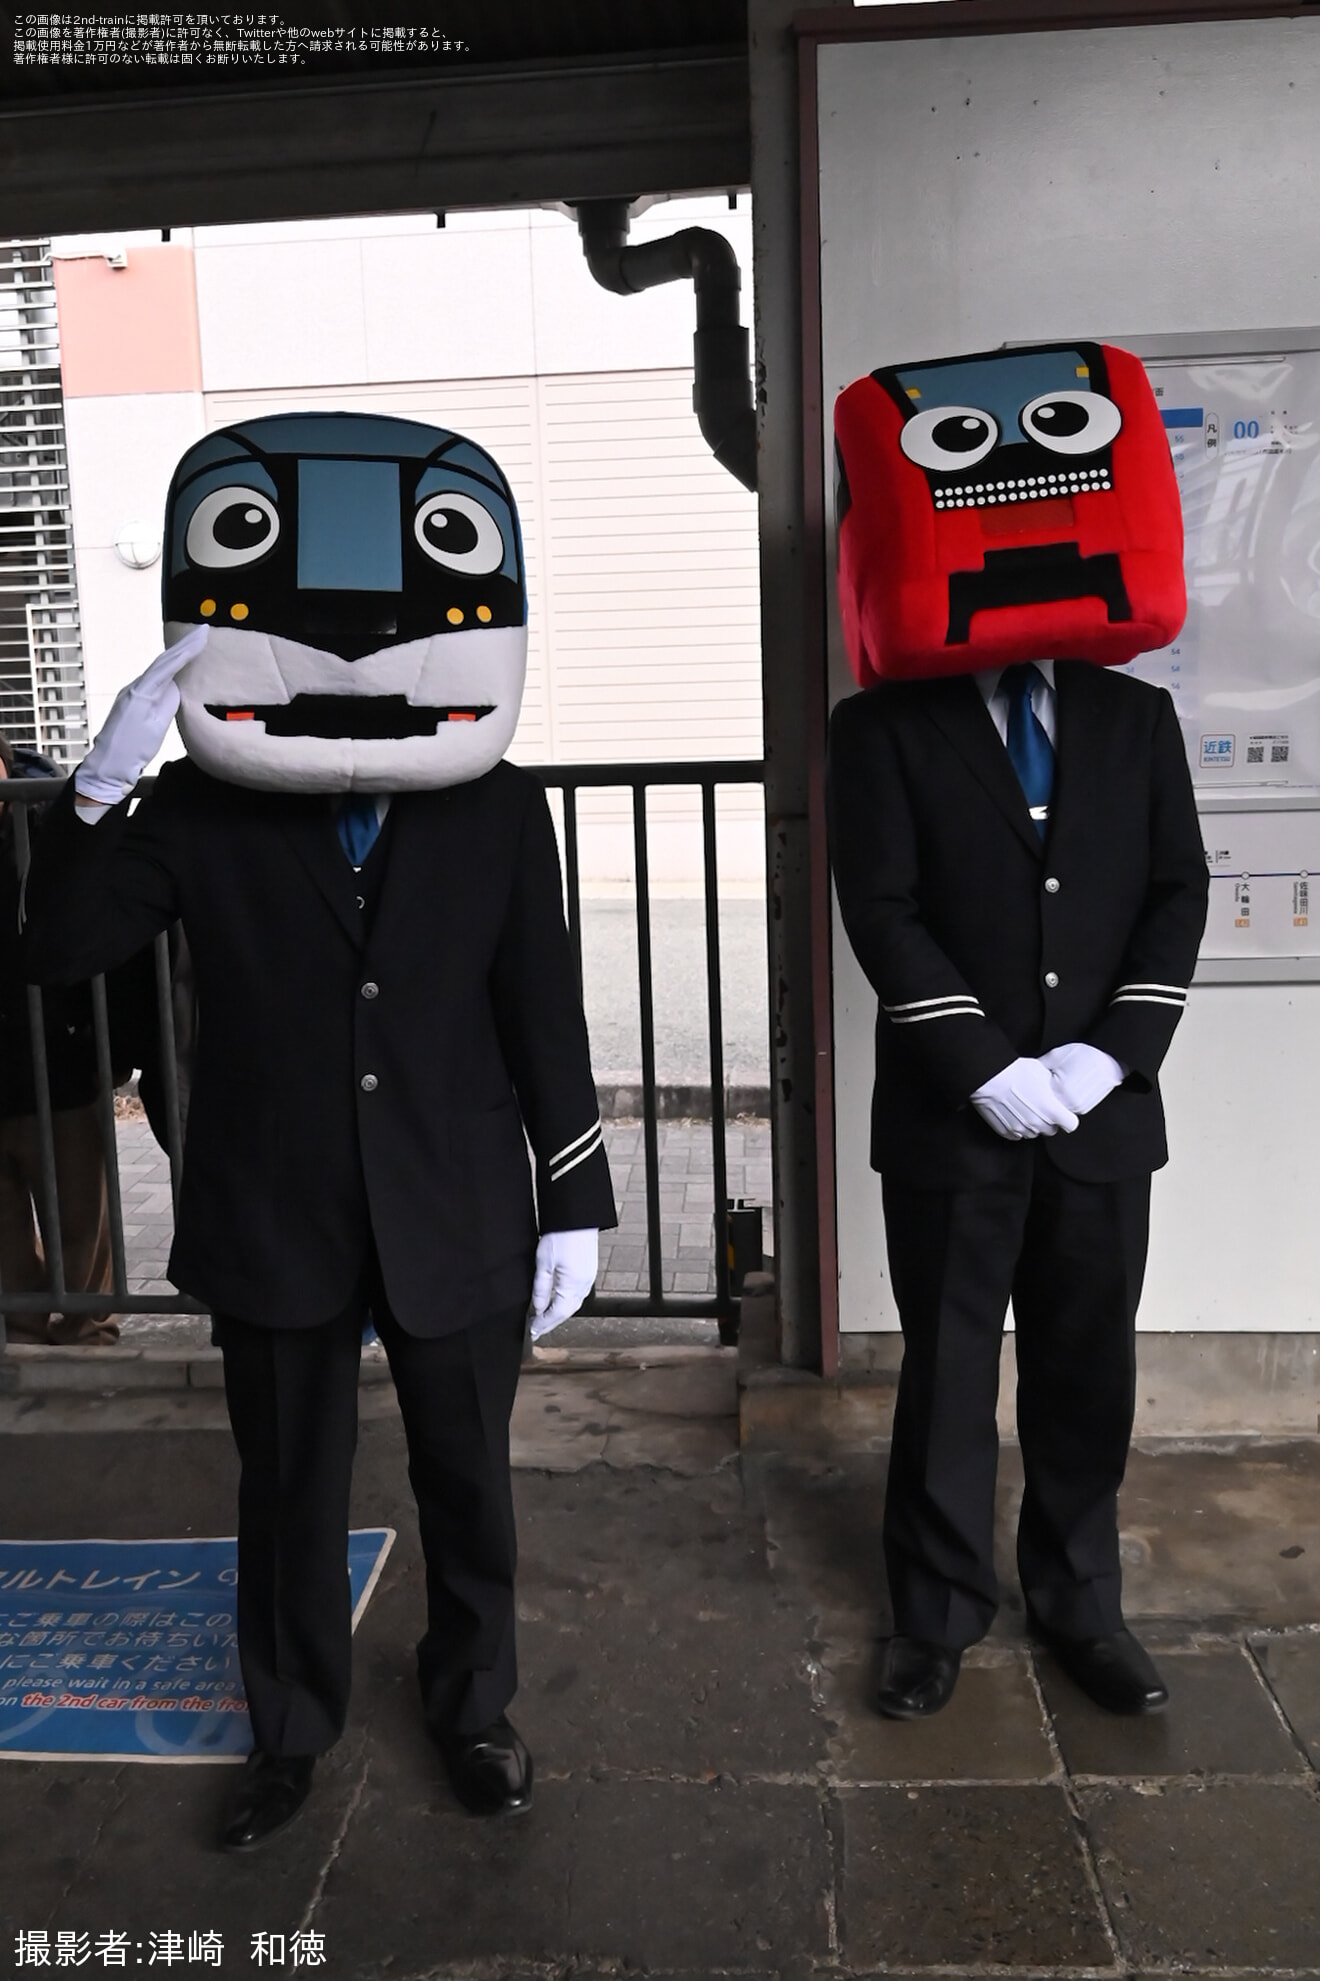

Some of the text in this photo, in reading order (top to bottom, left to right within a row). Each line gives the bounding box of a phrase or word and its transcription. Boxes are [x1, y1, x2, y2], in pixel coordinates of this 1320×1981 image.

[1233, 420, 1259, 439] 00
[1203, 740, 1232, 754] 近鉄
[2, 1676, 63, 1690] please
[68, 1677, 110, 1689] wait
[113, 1677, 131, 1690] in
[135, 1680, 147, 1690] a
[153, 1678, 191, 1691] safe
[195, 1681, 235, 1691] area
[22, 1692, 55, 1707] the
[55, 1694, 97, 1708] 2nd
[98, 1698, 128, 1709] car
[129, 1695, 176, 1711] from
[181, 1696, 211, 1711] the
